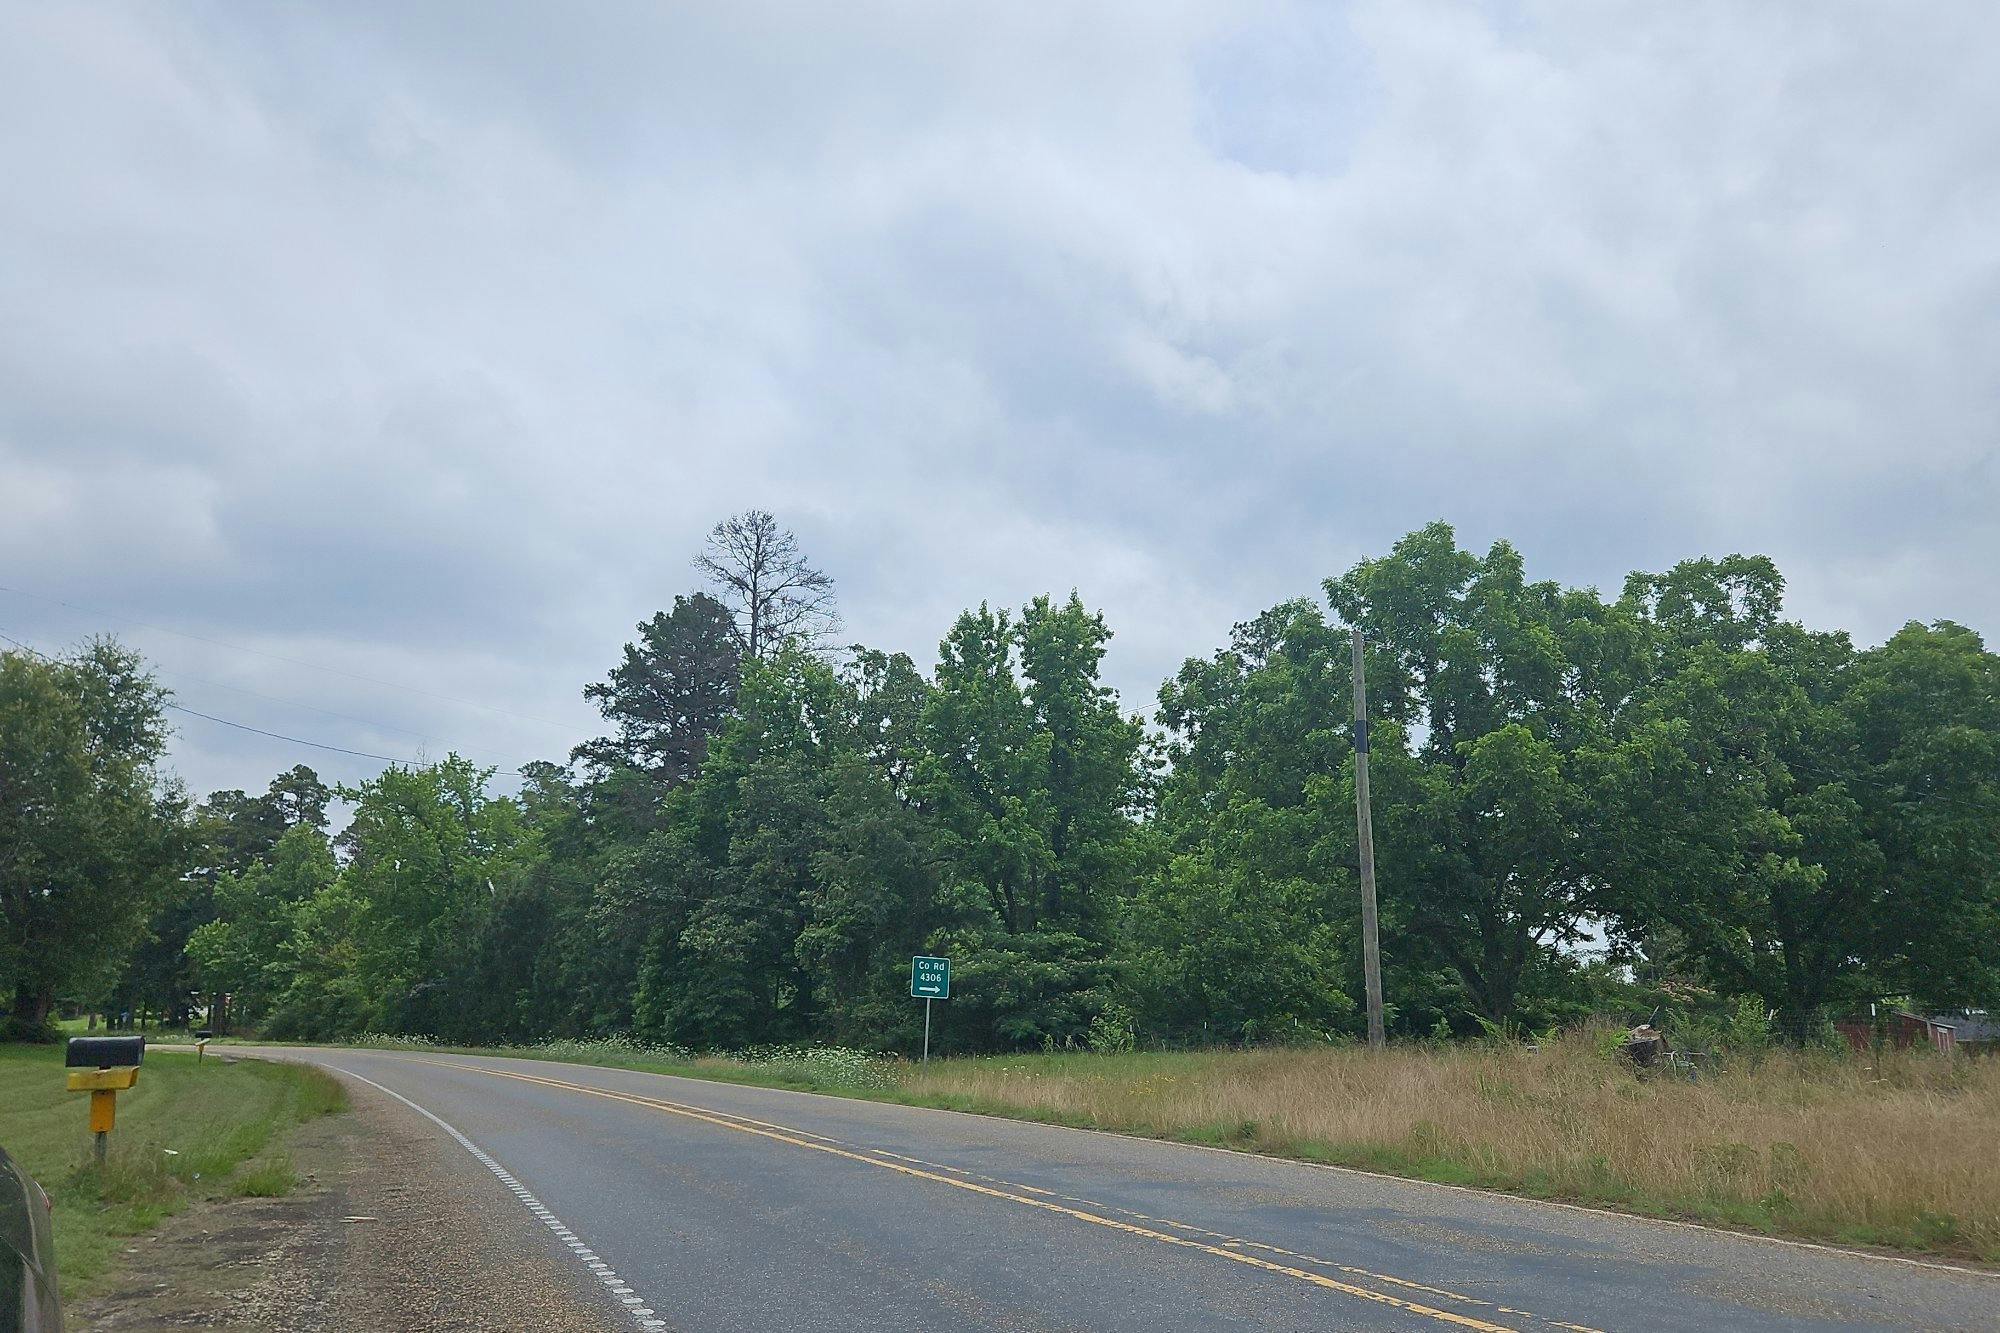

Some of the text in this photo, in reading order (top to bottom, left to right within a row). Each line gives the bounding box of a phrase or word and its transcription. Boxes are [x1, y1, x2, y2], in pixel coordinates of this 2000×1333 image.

[918, 961, 945, 971] Co Rd
[920, 973, 942, 982] 4306
